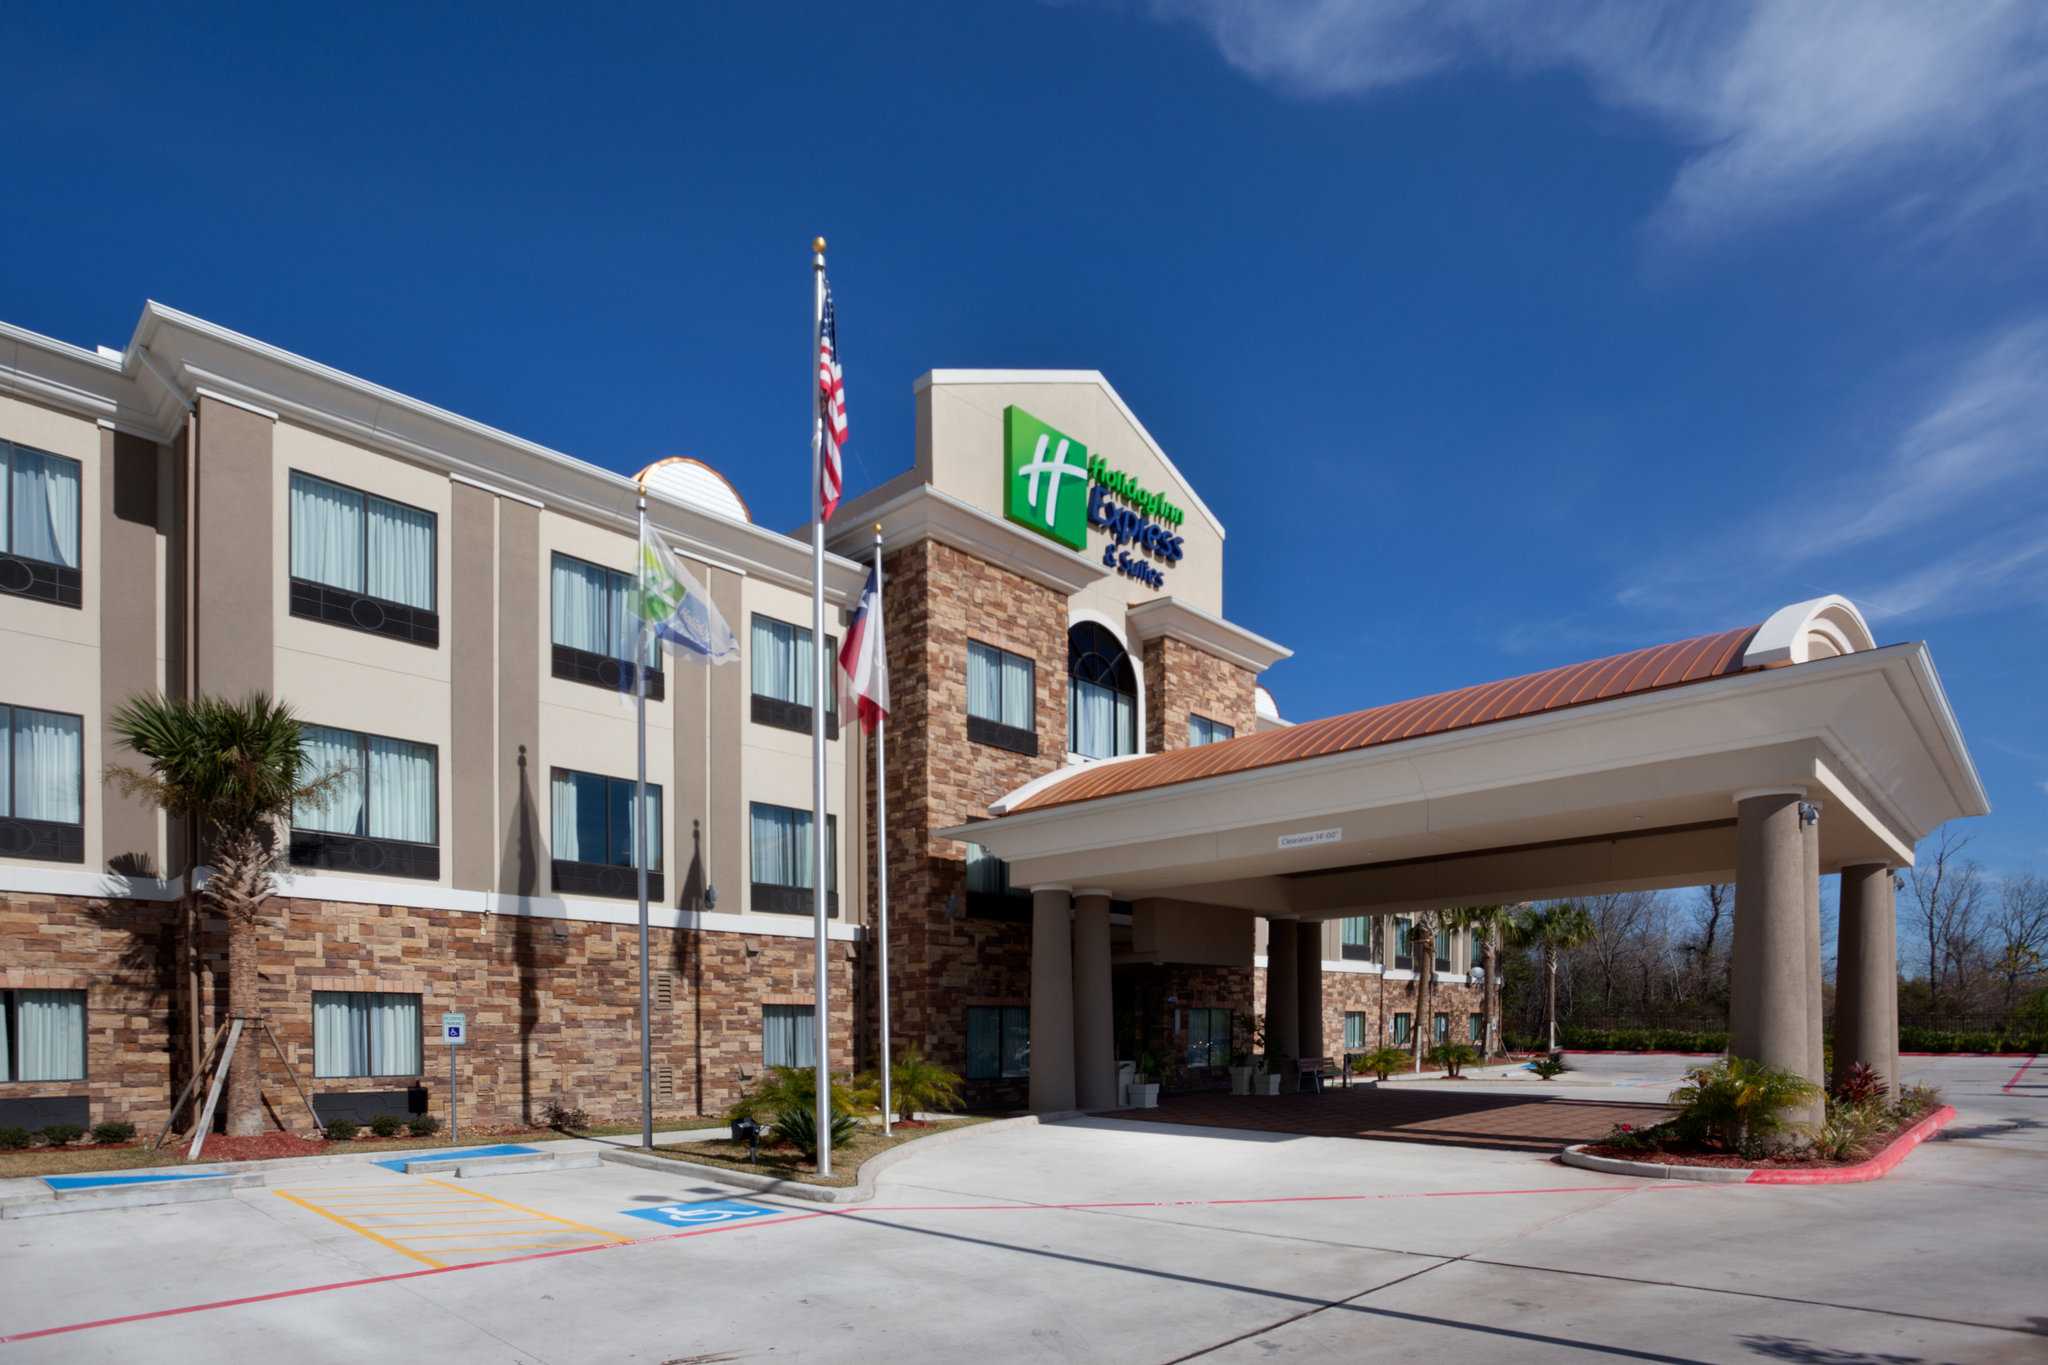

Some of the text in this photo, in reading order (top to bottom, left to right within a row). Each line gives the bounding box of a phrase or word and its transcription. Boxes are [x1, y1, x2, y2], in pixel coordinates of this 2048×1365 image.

[1088, 454, 1184, 526] Holiday Inn
[1088, 484, 1184, 561] Express
[1103, 543, 1164, 588] & Suites
